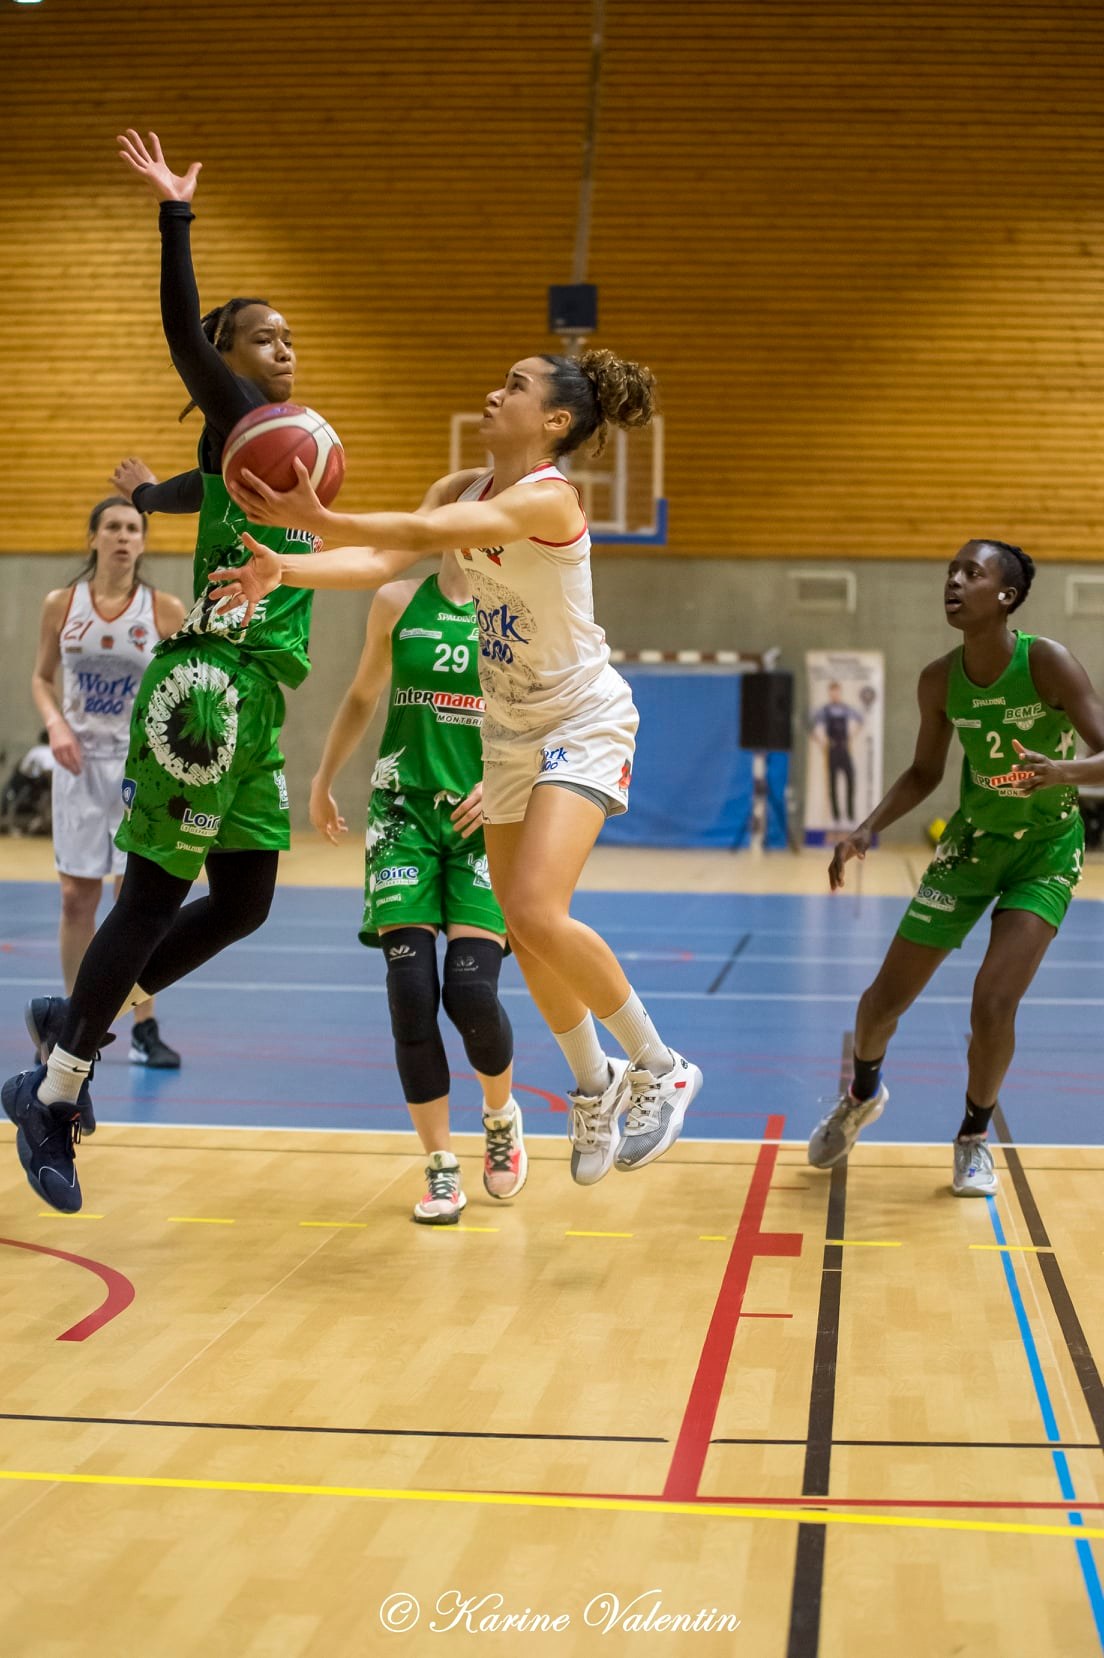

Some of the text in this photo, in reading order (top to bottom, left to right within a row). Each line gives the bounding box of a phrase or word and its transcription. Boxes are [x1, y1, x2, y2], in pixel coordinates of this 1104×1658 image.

[437, 612, 477, 624] SPALDING
[63, 620, 93, 641] 21
[433, 643, 470, 674] 29
[78, 671, 138, 699] Work
[84, 697, 125, 715] 2000
[394, 686, 487, 713] Intermarc
[437, 714, 483, 727] MONTBRI
[986, 731, 1004, 759] 2
